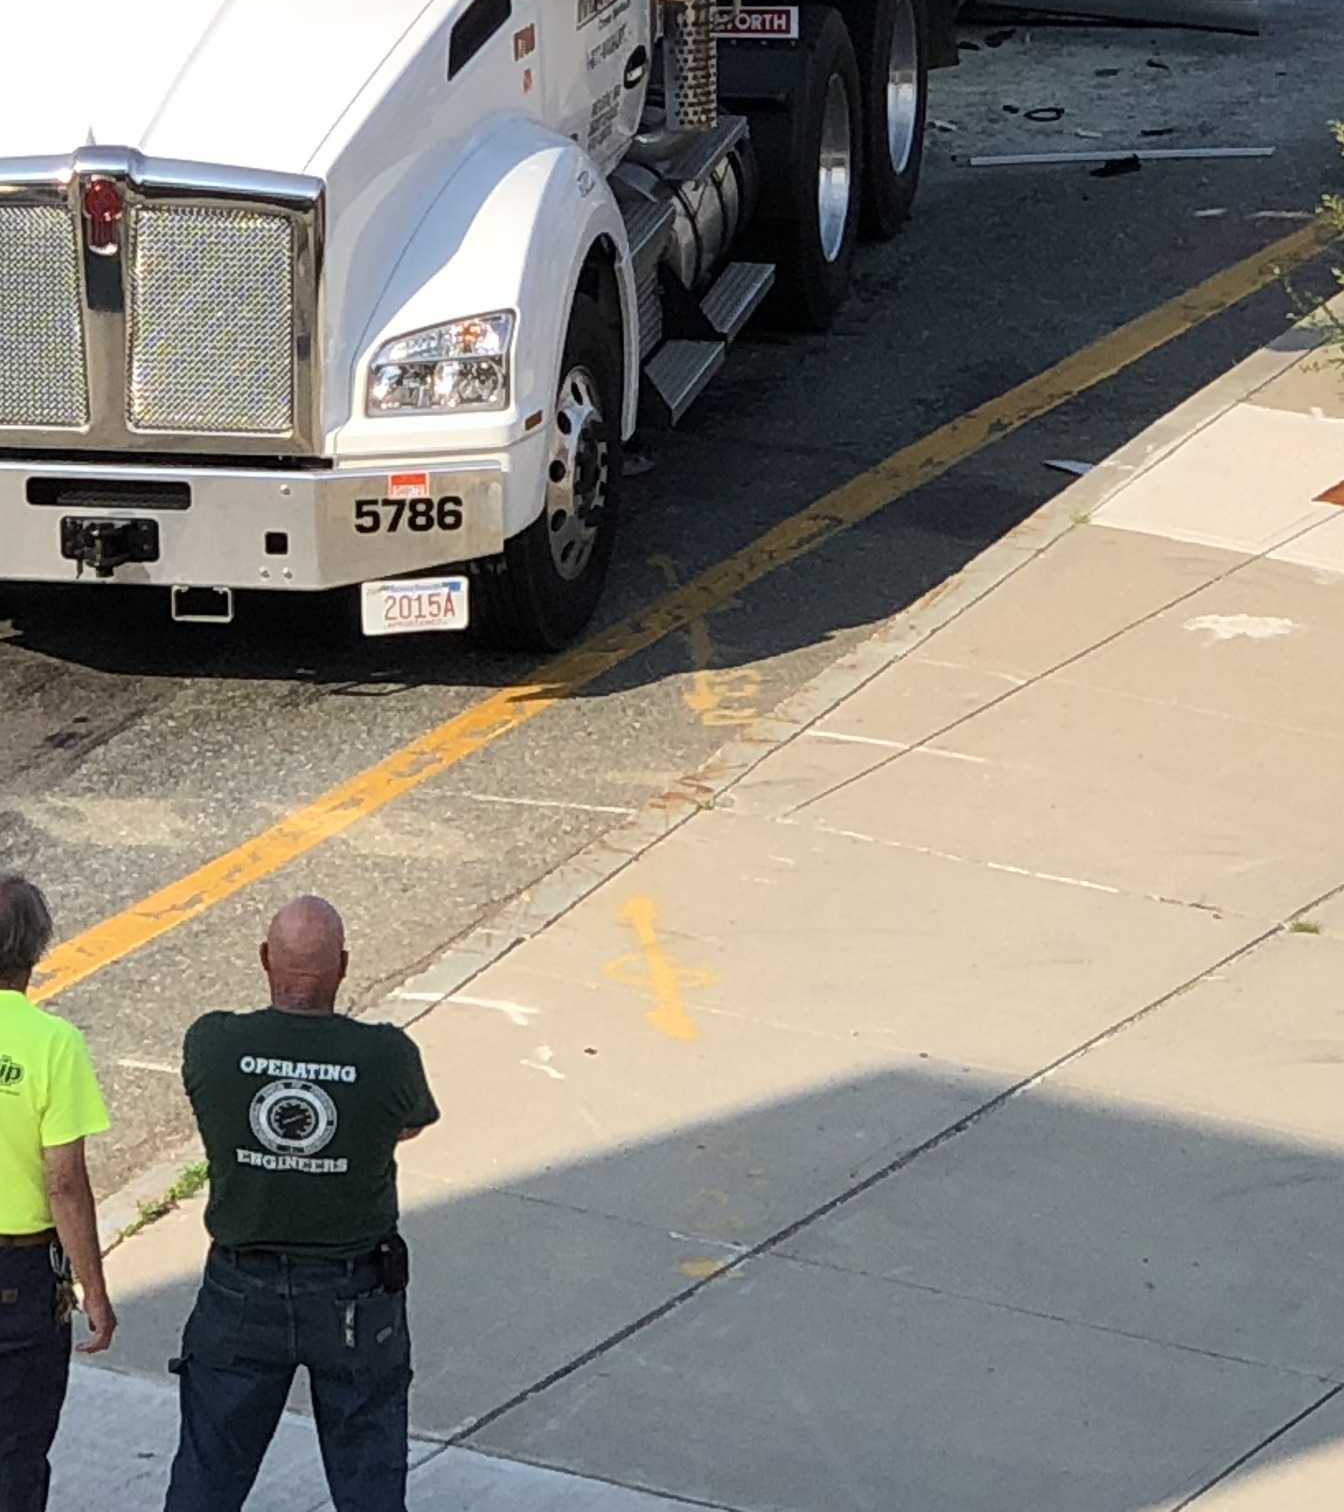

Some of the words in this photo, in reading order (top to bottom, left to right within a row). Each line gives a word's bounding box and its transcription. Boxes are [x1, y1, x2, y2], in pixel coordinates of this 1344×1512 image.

[355, 496, 463, 534] 5786
[384, 589, 456, 621] 2015A
[240, 1055, 357, 1083] OPERATING
[236, 1148, 348, 1174] ENGINEERS
